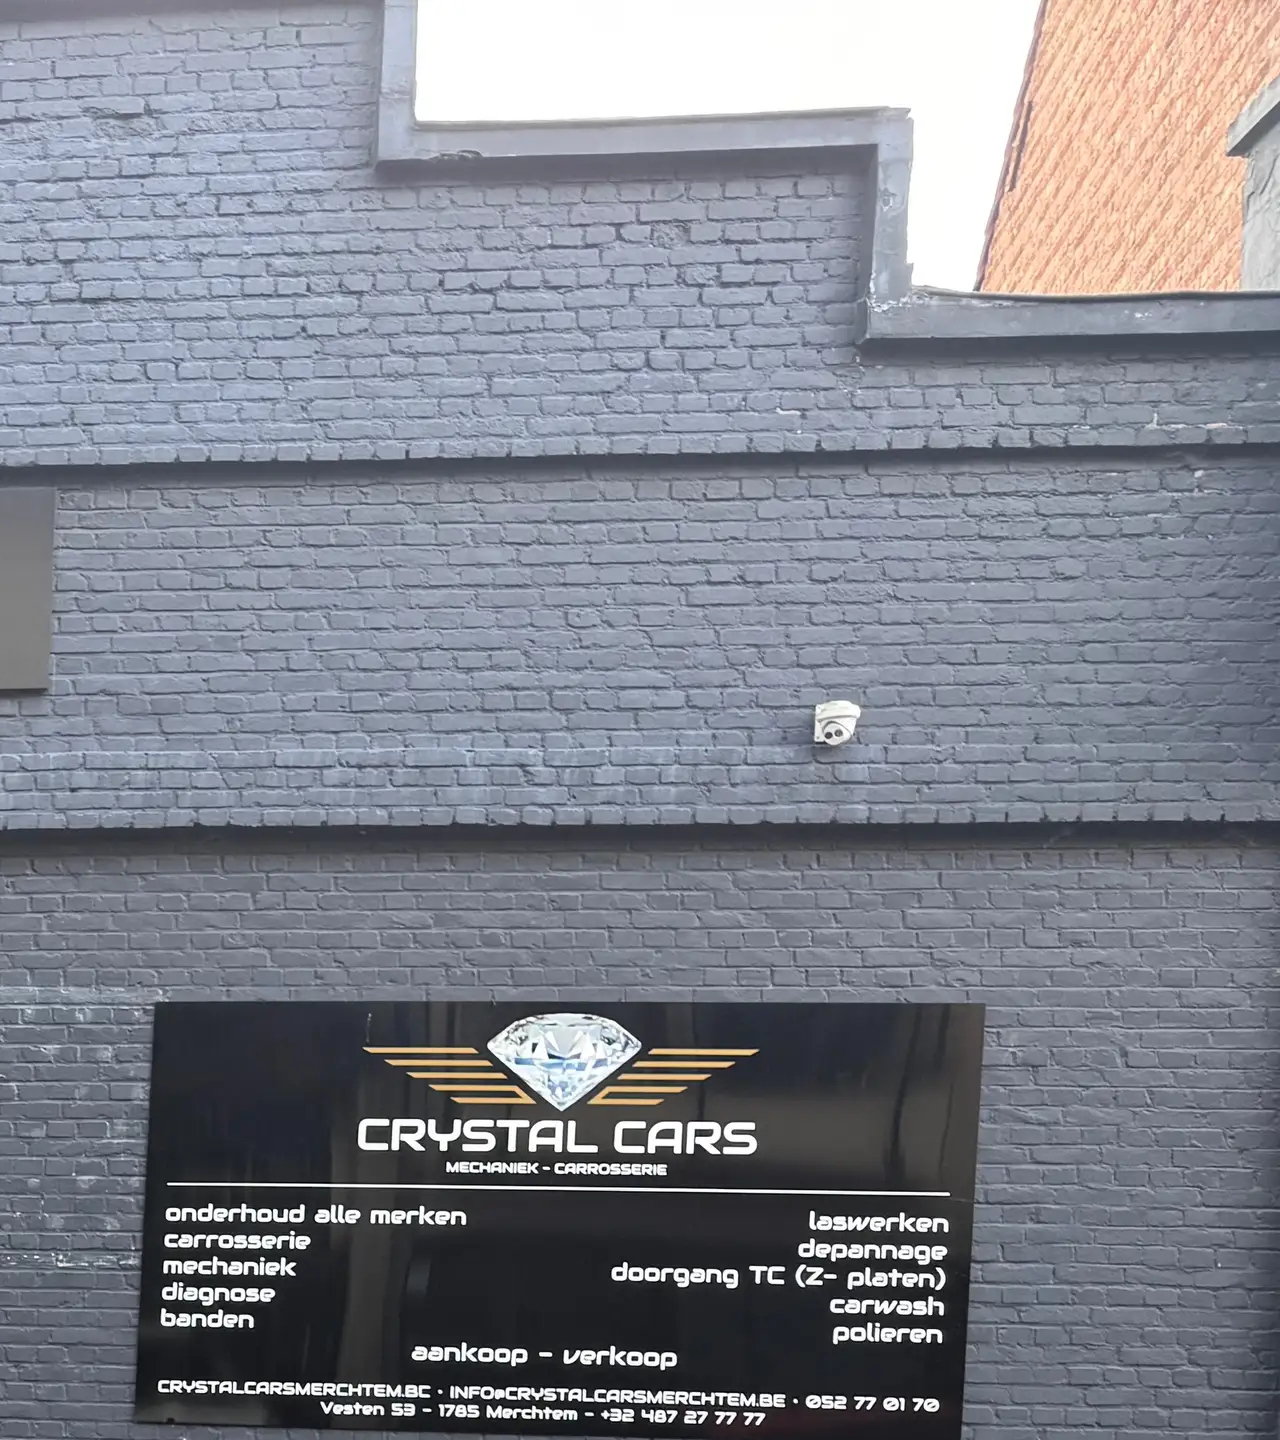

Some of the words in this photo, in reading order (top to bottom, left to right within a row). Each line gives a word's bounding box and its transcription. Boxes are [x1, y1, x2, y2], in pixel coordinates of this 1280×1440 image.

[357, 1118, 599, 1154] CRYSTAL
[613, 1120, 758, 1156] CARS
[445, 1161, 540, 1175] MECHANIEK
[553, 1162, 668, 1176] CARROSSERIE
[165, 1203, 306, 1224] onderhoud
[314, 1204, 362, 1225] alle
[369, 1205, 467, 1226] merken
[808, 1210, 950, 1234] laswerken
[163, 1230, 312, 1250] carrosserie
[797, 1238, 949, 1266] depannage
[162, 1256, 297, 1277] mechaniek
[610, 1261, 739, 1289] doorgang
[748, 1265, 786, 1285] TC
[794, 1264, 838, 1289] (Z-
[846, 1266, 947, 1291] platen)
[161, 1282, 276, 1307] diagnose
[829, 1296, 945, 1317] carwash
[160, 1308, 255, 1329] banden
[832, 1323, 944, 1345] polieren
[410, 1341, 529, 1367] aankoop
[562, 1345, 678, 1371] verkoop
[449, 1385, 786, 1408] INFO@CRYSTALCARSMERCHTEM.BE
[805, 1394, 848, 1410] 052
[853, 1395, 877, 1411] 77
[882, 1396, 906, 1412] 01
[911, 1397, 940, 1413] 70
[319, 1400, 385, 1416] Vesten
[390, 1402, 416, 1417] 53
[438, 1403, 481, 1418] 1785
[485, 1404, 579, 1421] Merchtem
[600, 1408, 635, 1423] +32
[640, 1408, 679, 1424] 487
[683, 1410, 709, 1425] 27
[714, 1410, 738, 1426] 77
[743, 1411, 766, 1426] 77
